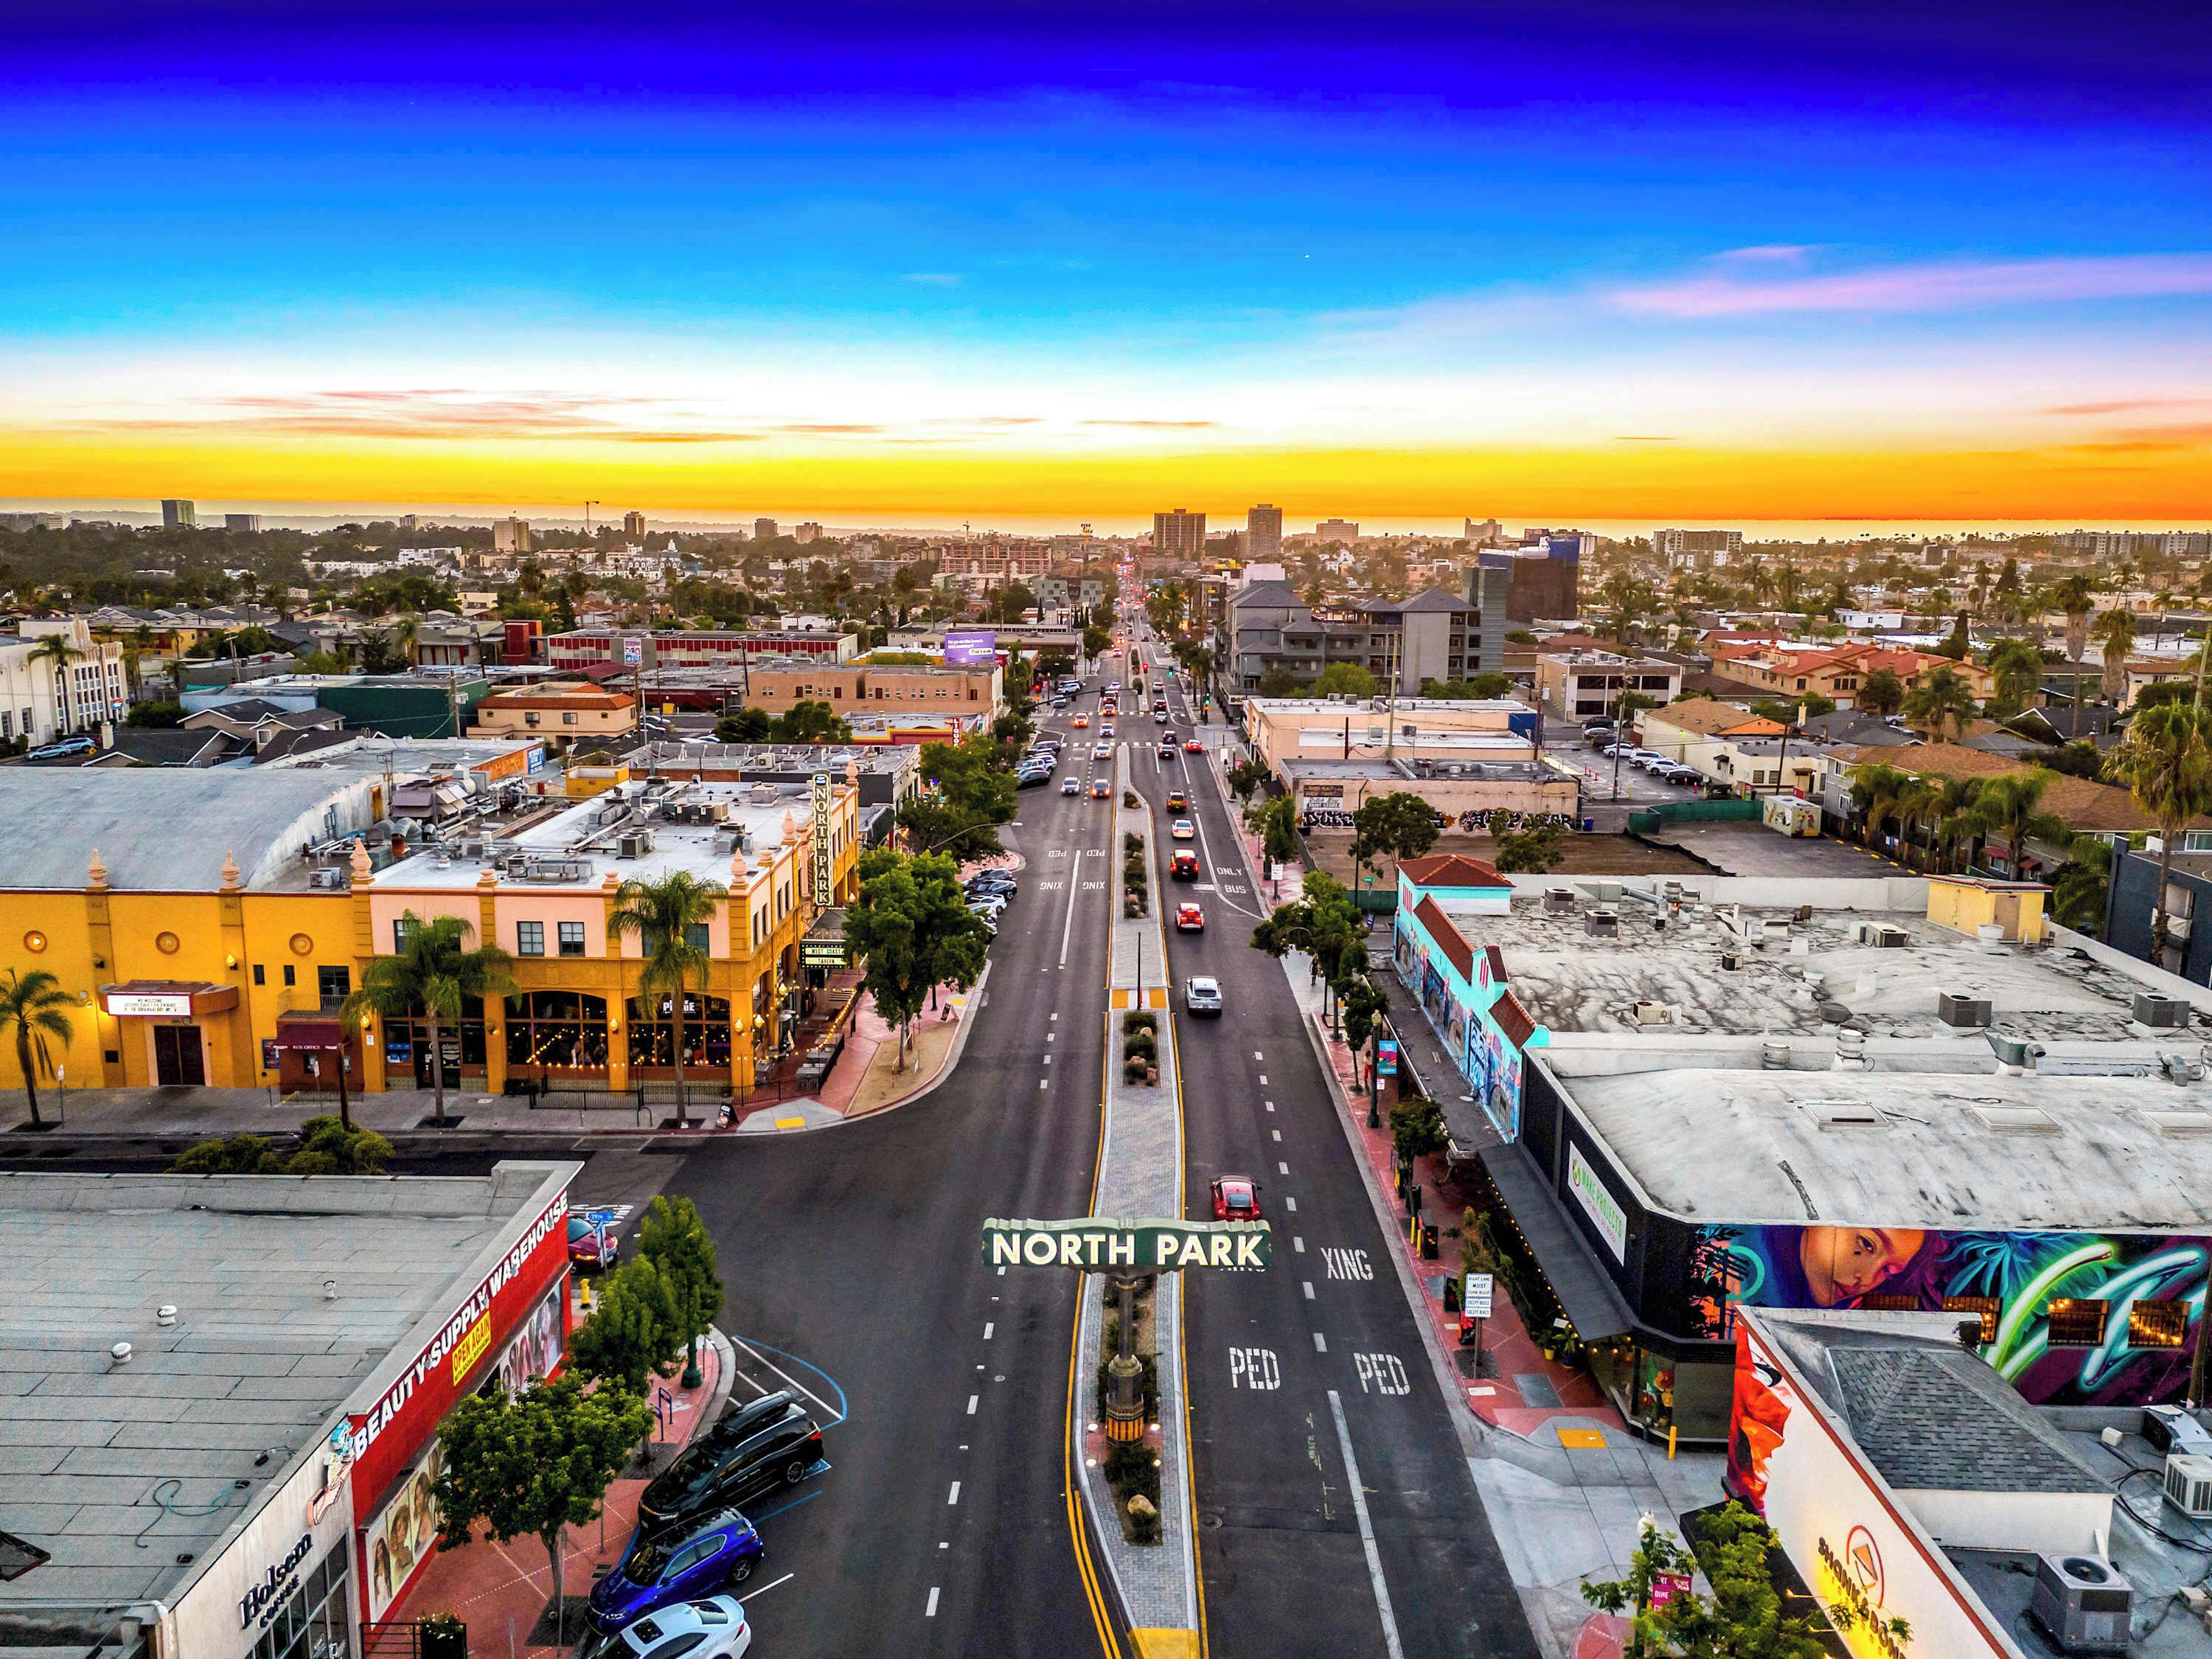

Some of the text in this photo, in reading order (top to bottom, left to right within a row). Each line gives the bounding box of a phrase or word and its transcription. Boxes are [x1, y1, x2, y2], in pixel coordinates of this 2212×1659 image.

[815, 787, 827, 849] NORTH
[1048, 849, 1068, 858] PED
[1217, 867, 1242, 876] ONLY
[818, 855, 829, 902] PARK
[1040, 881, 1063, 890] XING
[1082, 881, 1105, 890] XING
[1225, 884, 1246, 894] BUS
[1582, 1167, 1622, 1239] MAKE PROJECTS
[992, 1233, 1264, 1266] NORTH PARK
[1320, 1248, 1374, 1281] XING
[354, 1191, 568, 1461] BEAUTY SUPPLY WAREHOUSE
[453, 1314, 490, 1371] OPEN AGAIN
[1229, 1347, 1281, 1391] PED
[1354, 1352, 1411, 1396] PED
[240, 1534, 313, 1629] Holsem
[1654, 1590, 1669, 1599] DINE
[1818, 1537, 1861, 1608] SHANK
